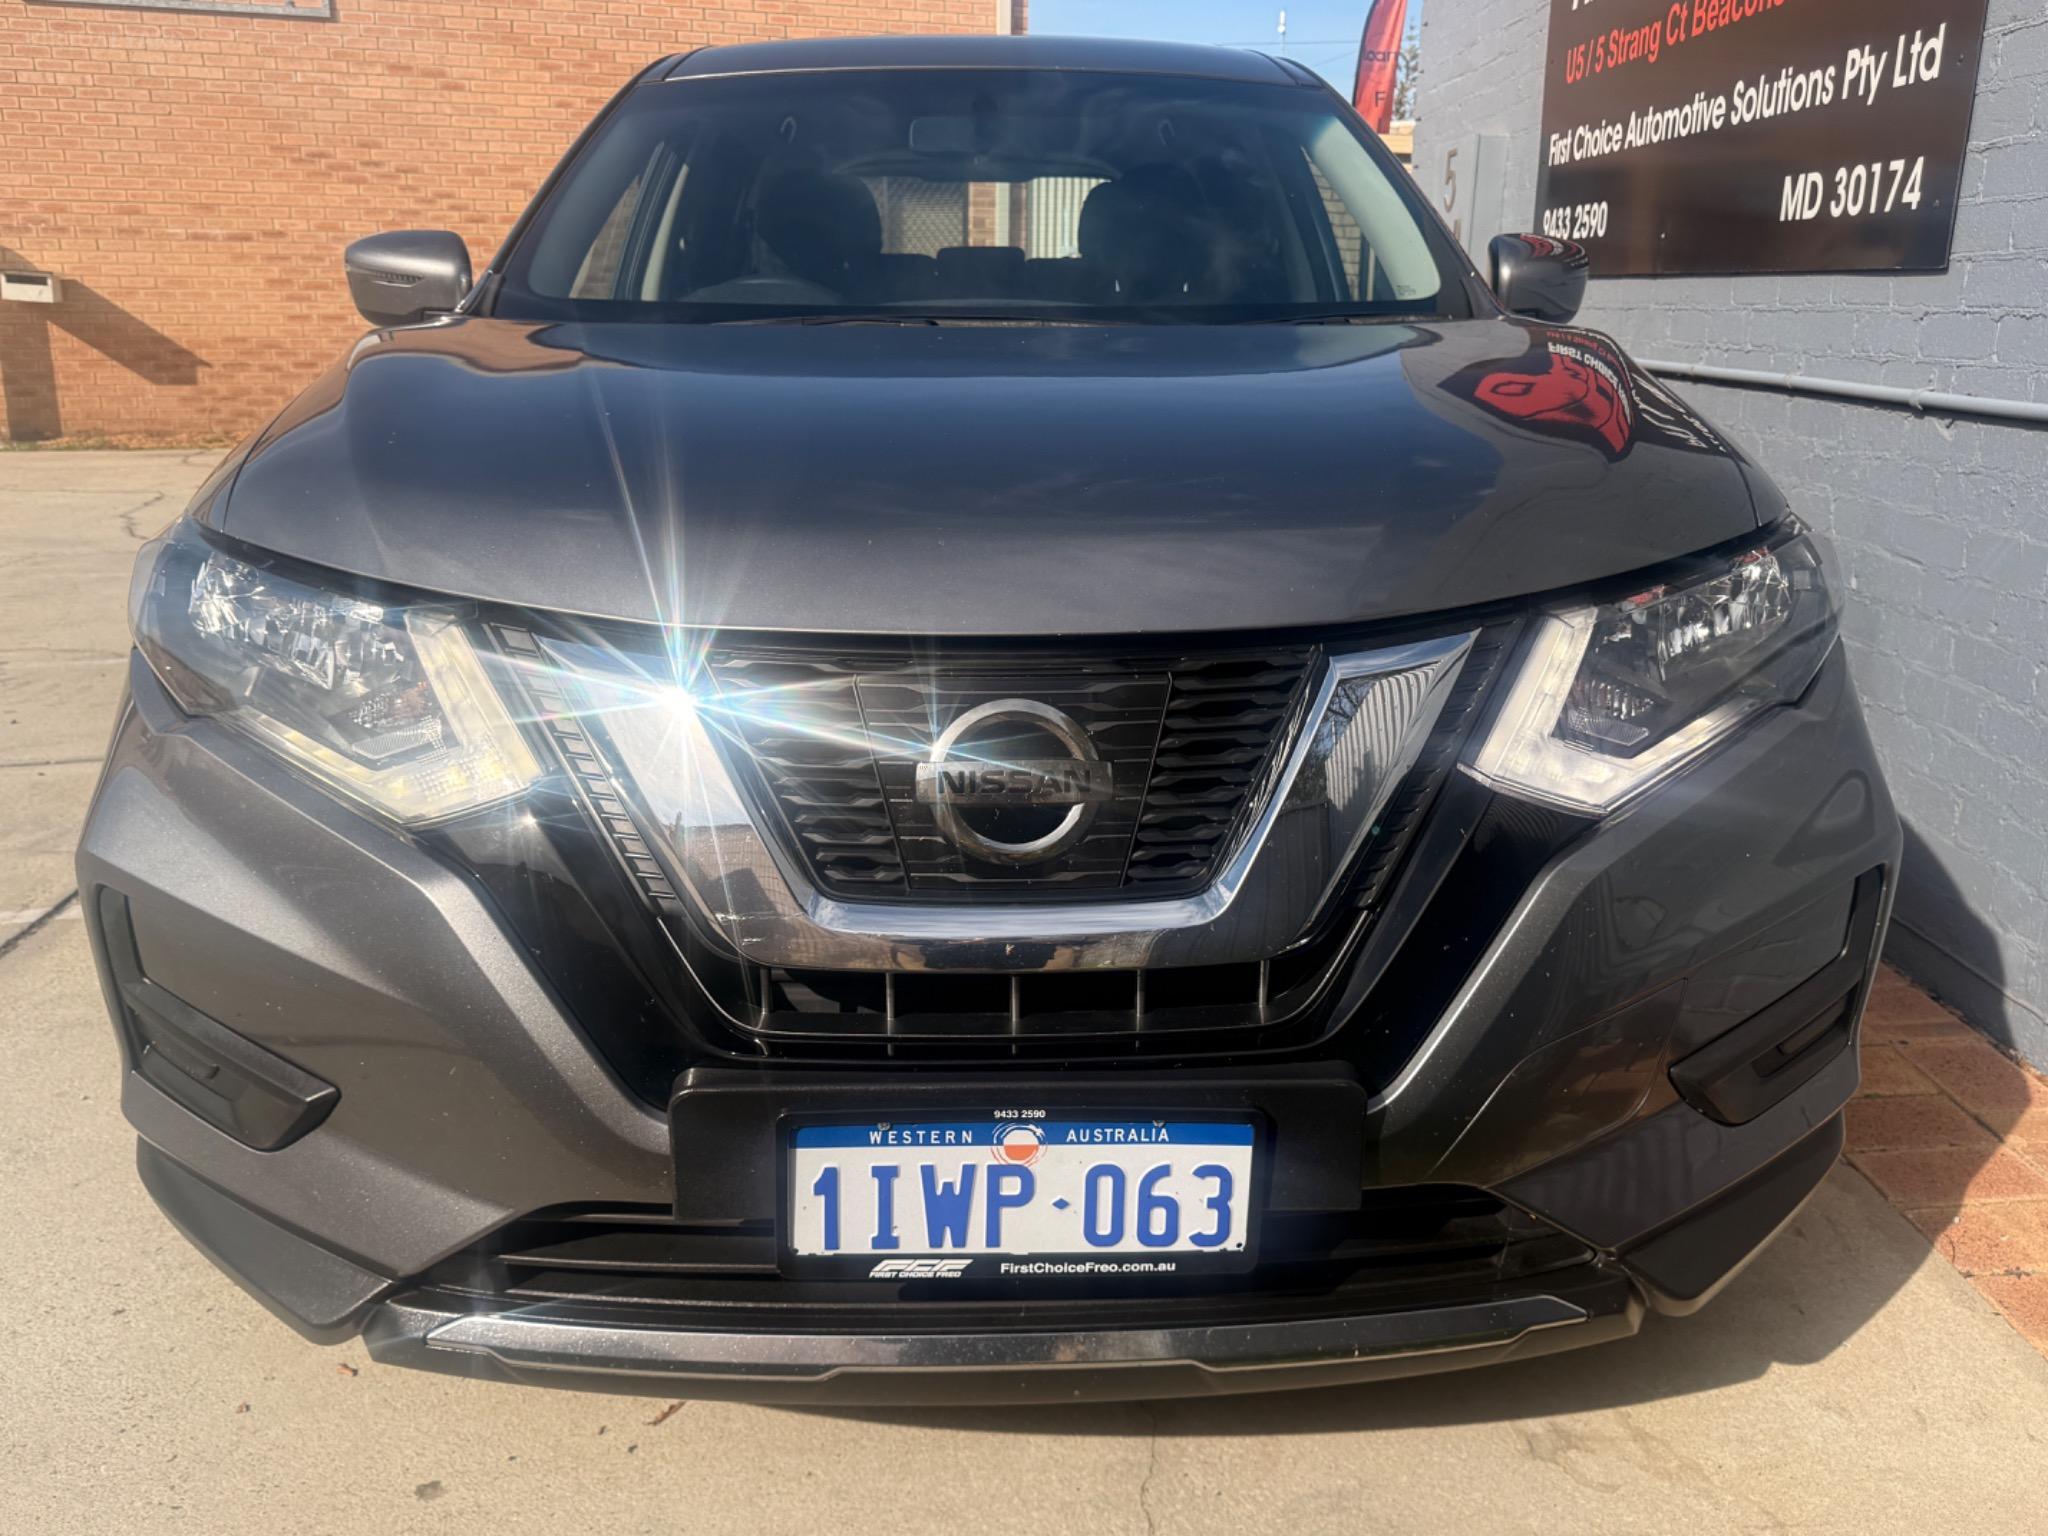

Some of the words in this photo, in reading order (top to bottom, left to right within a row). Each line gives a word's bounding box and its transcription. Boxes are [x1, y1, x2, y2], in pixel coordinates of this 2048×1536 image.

[1566, 44, 1585, 84] U5
[1595, 35, 1605, 73] 5
[1607, 20, 1662, 69] Strang
[1666, 2, 1687, 47] Ct
[1548, 128, 1573, 167] First
[1573, 119, 1624, 161] Choice
[1624, 91, 1727, 150] Automotive
[1730, 65, 1836, 126] Solutions
[1841, 44, 1889, 106] Pty
[1892, 22, 1947, 89] Ltd
[1443, 148, 1458, 213] 5
[1779, 171, 1824, 222] MD
[1829, 155, 1925, 218] 30174
[1542, 206, 1571, 240] 9433
[1572, 201, 1609, 239] 2590
[938, 769, 1091, 795] NISSAN
[993, 1109, 1018, 1119] 9433
[1021, 1109, 1046, 1119] 2590
[869, 1130, 973, 1144] WESTERN
[1066, 1128, 1169, 1143] AUSTRALIA
[869, 1271, 898, 1279] FIRST
[898, 1271, 935, 1279] CHOICE
[1000, 1261, 1176, 1274] FirstChoiceFreo.com.au
